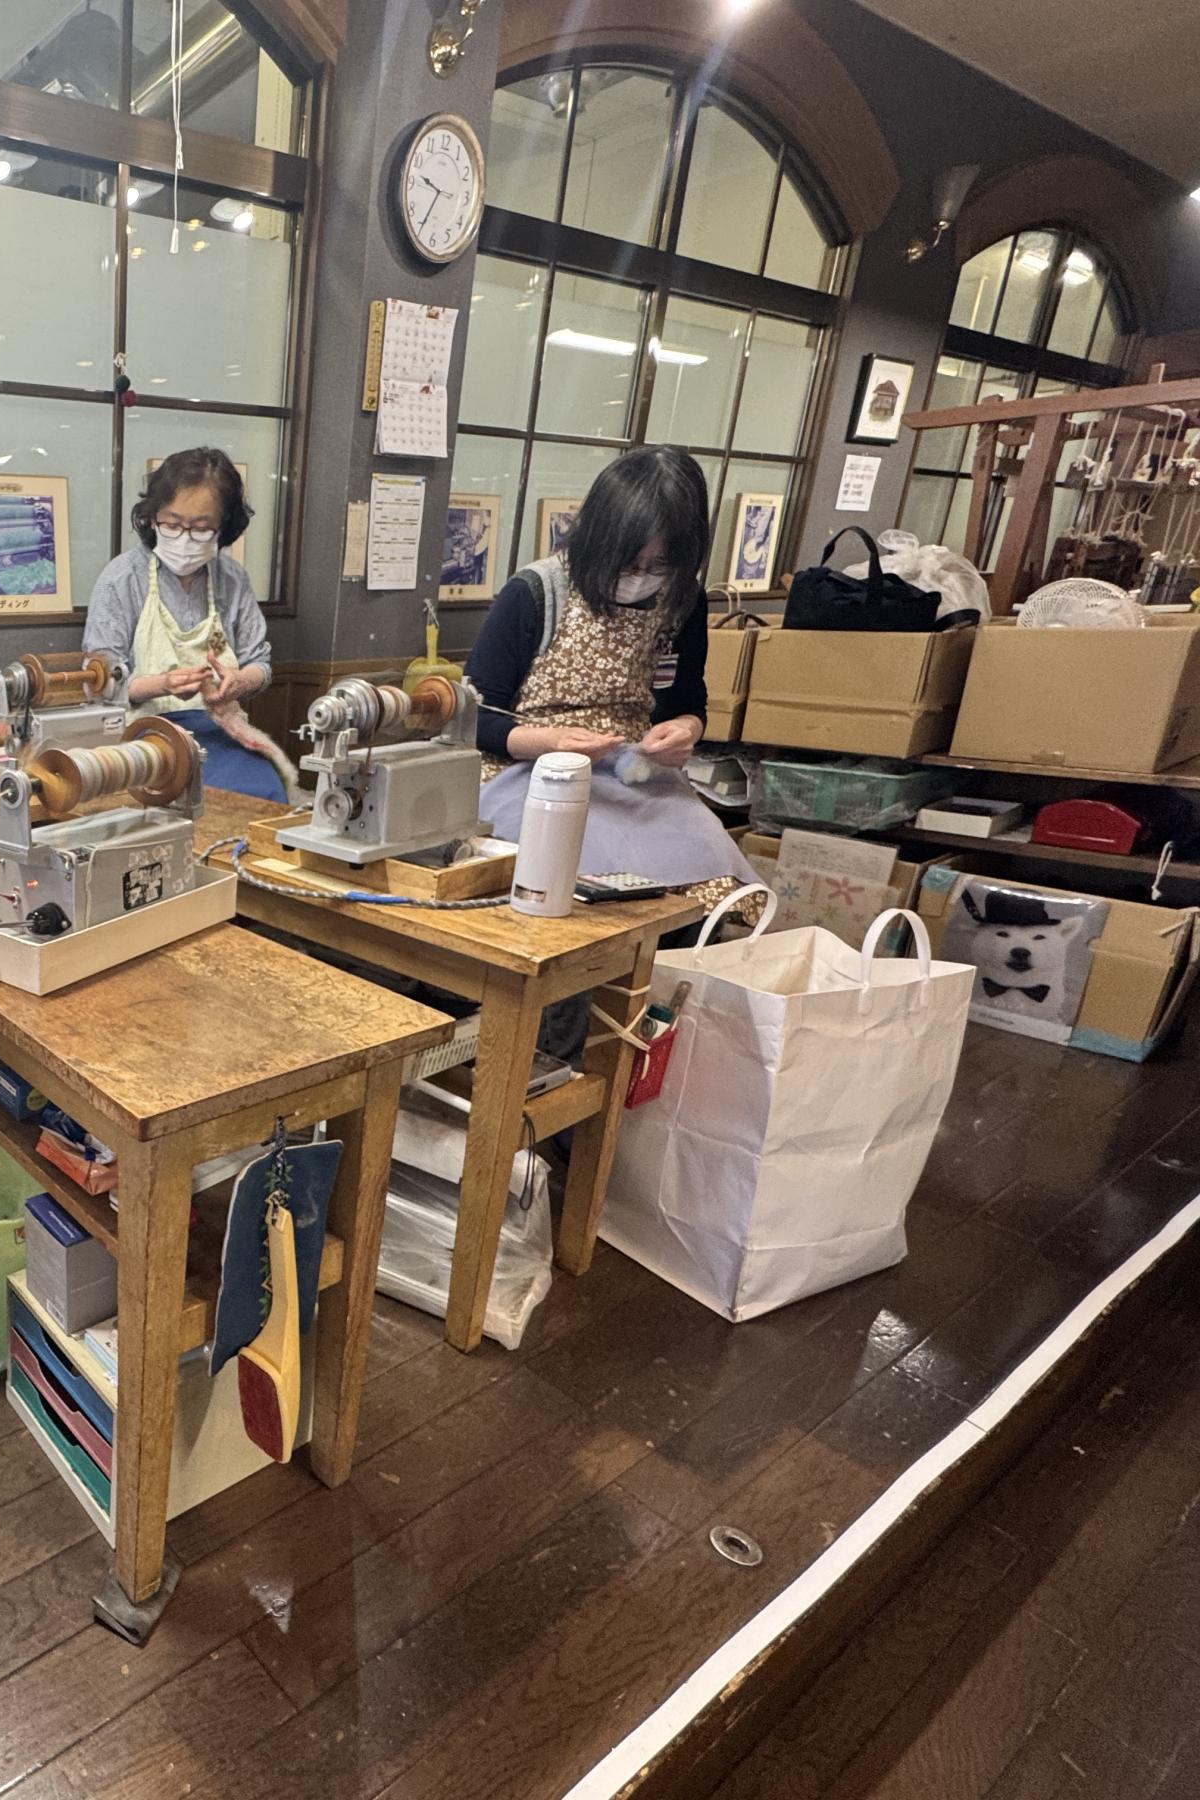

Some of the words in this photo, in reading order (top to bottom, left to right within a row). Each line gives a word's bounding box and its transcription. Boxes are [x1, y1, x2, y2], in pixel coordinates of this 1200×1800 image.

[425, 136, 435, 153] 11
[440, 133, 452, 151] 12
[413, 152, 424, 169] 10
[455, 145, 461, 160] 1
[462, 165, 470, 182] 2
[407, 175, 415, 191] 9
[462, 190, 470, 206] 3
[408, 200, 416, 217] 8
[455, 214, 464, 230] 4
[428, 232, 437, 248] 6
[443, 228, 452, 244] 5
